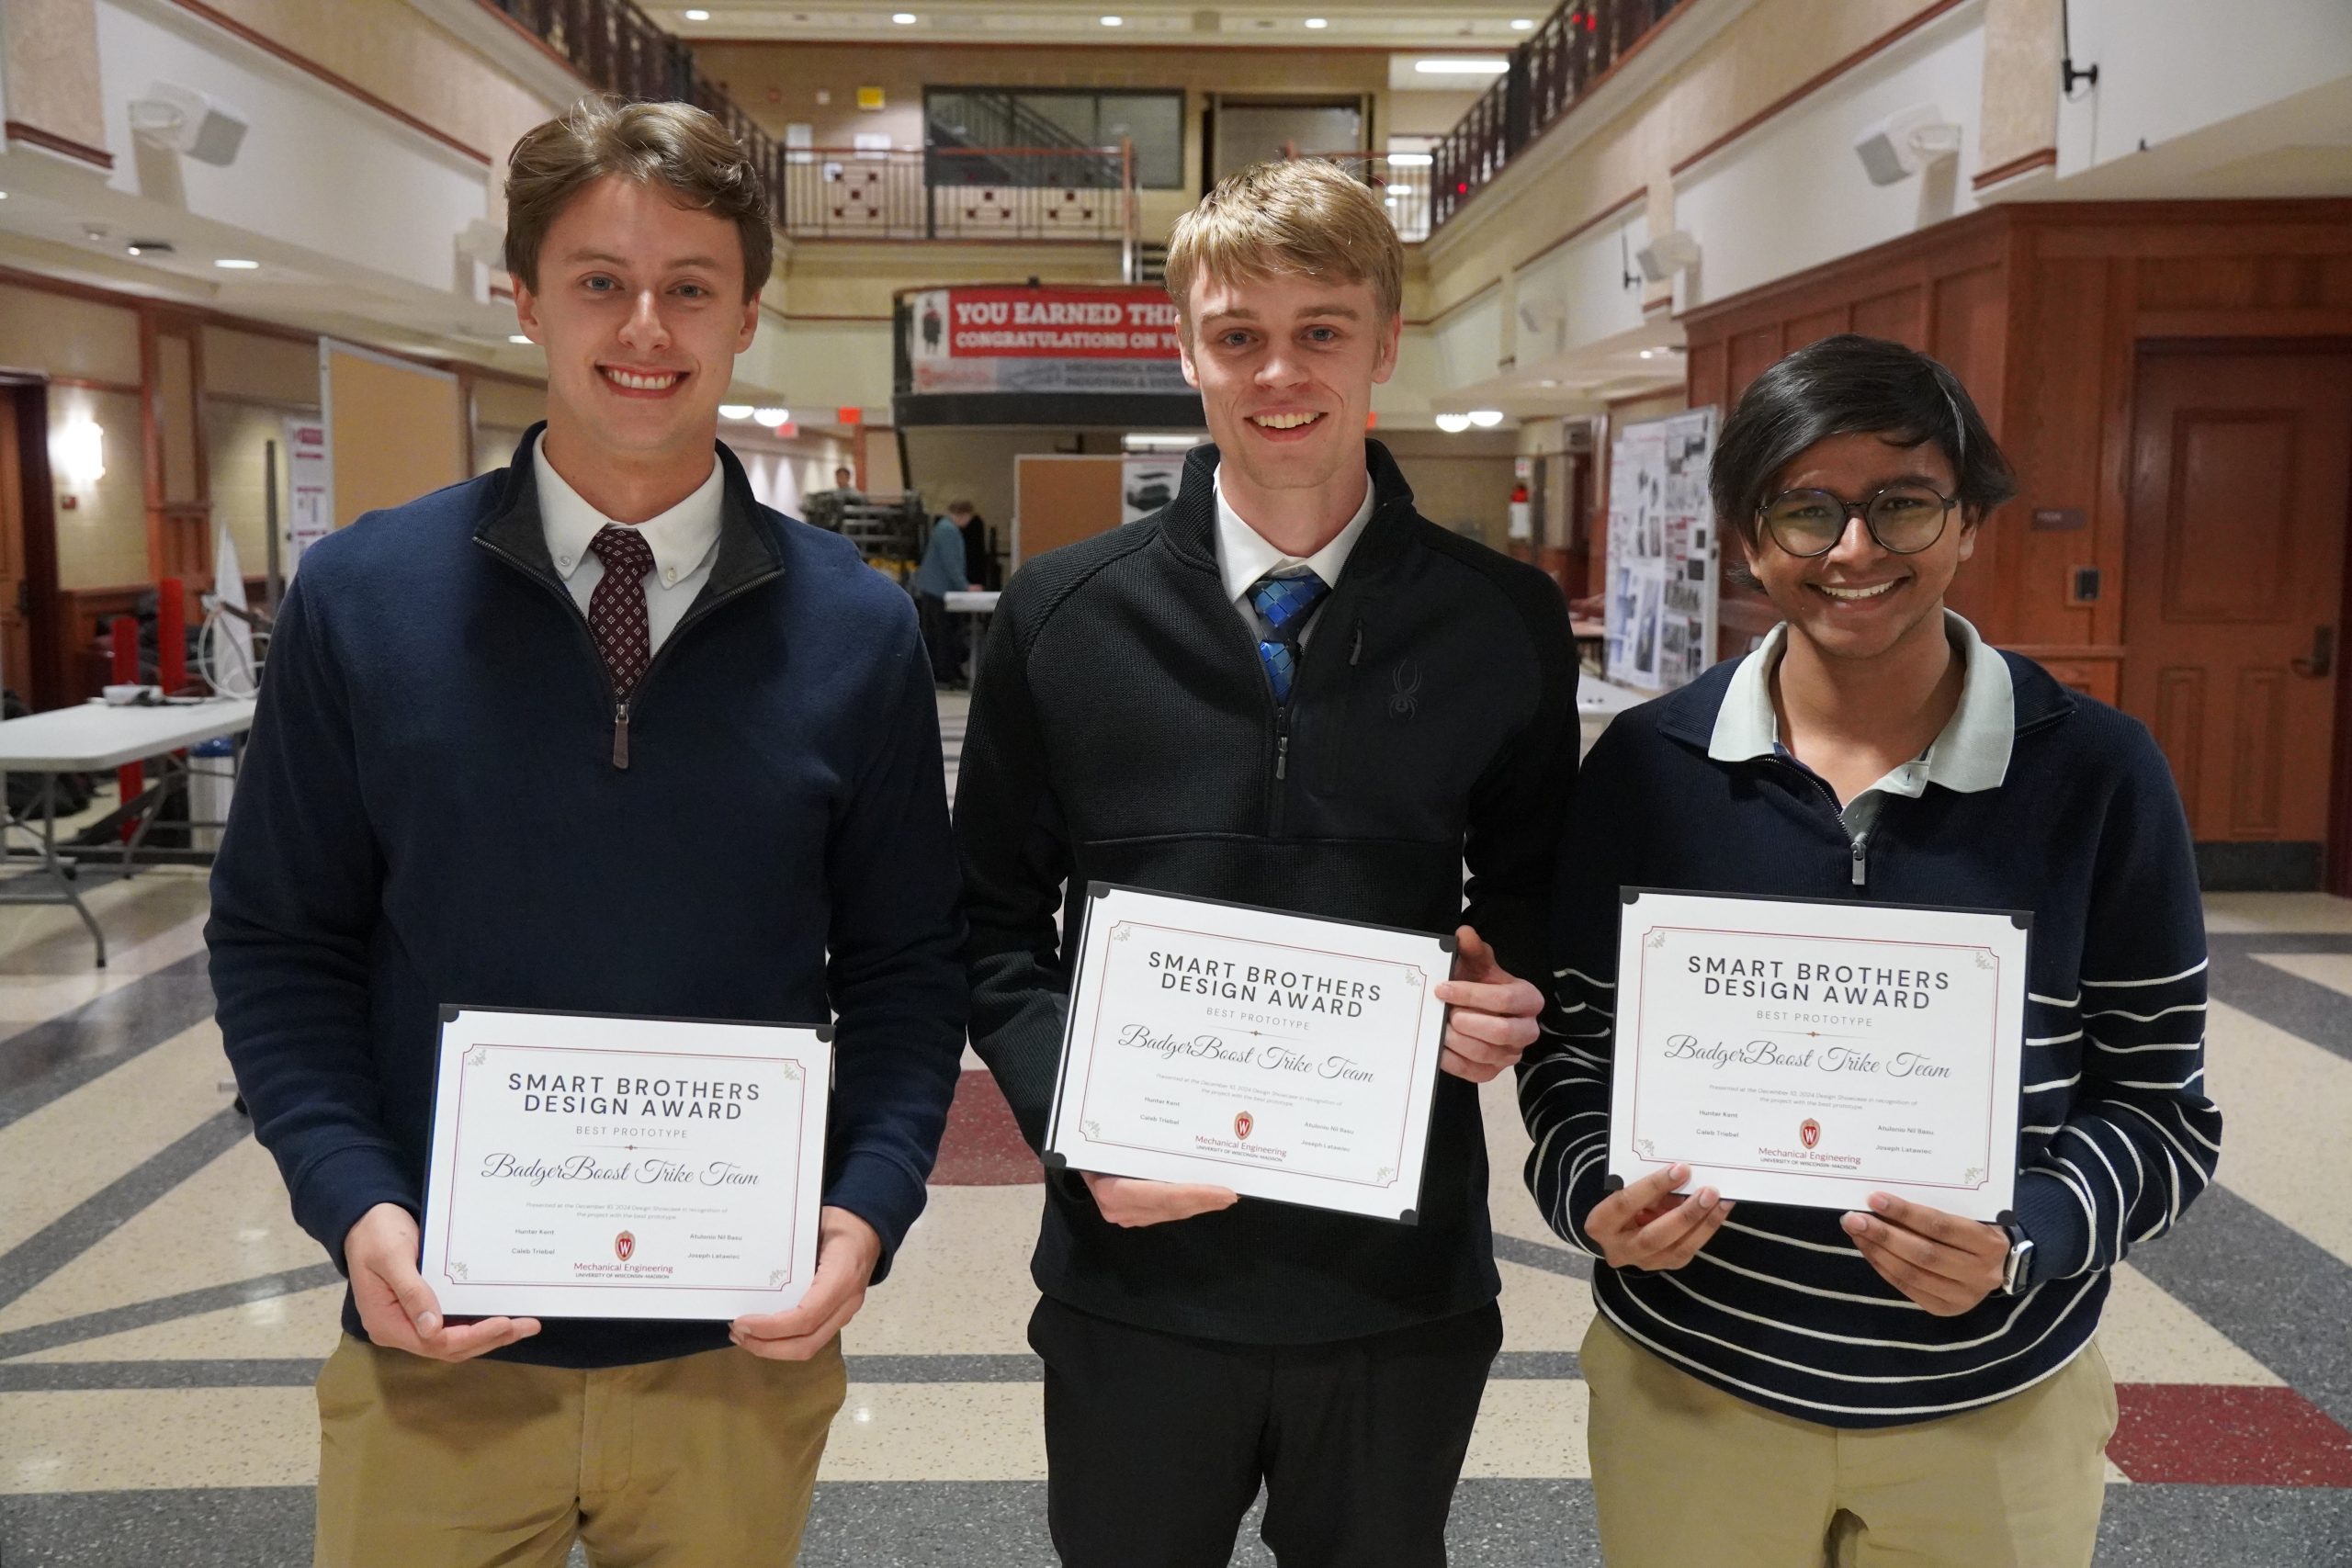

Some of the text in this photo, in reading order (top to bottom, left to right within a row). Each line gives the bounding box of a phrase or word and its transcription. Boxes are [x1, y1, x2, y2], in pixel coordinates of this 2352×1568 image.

[956, 301, 1177, 326] YOU EARNED THI
[956, 331, 1127, 349] CONGRATULATIONS
[1130, 332, 1158, 349] ON
[1148, 952, 1381, 1001] SMART BROTHERS
[1688, 956, 1949, 990] SMART BROTHERS
[1161, 973, 1363, 1018] DESIGN AWARD
[1704, 977, 1929, 1010] DESIGN AWARD
[1206, 1008, 1309, 1031] BEST PROTOTYPE
[1756, 1010, 1872, 1027] BEST PROTOTYPE
[1117, 1024, 1374, 1083] BadgerBoost Trike Team
[1664, 1034, 1951, 1078] BadgerBoost Trike Team
[508, 1073, 759, 1101] SMART BROTHERS
[524, 1095, 741, 1120] DESIGN AWARD
[576, 1126, 687, 1139] BEST PROTOTYPE
[1194, 1135, 1287, 1158] Mechanical Engineering
[1758, 1147, 1862, 1166] Mechanical Engineering
[481, 1154, 759, 1187] BadgerBoost Trike Team
[573, 1263, 673, 1274] Mechanical Engineering
